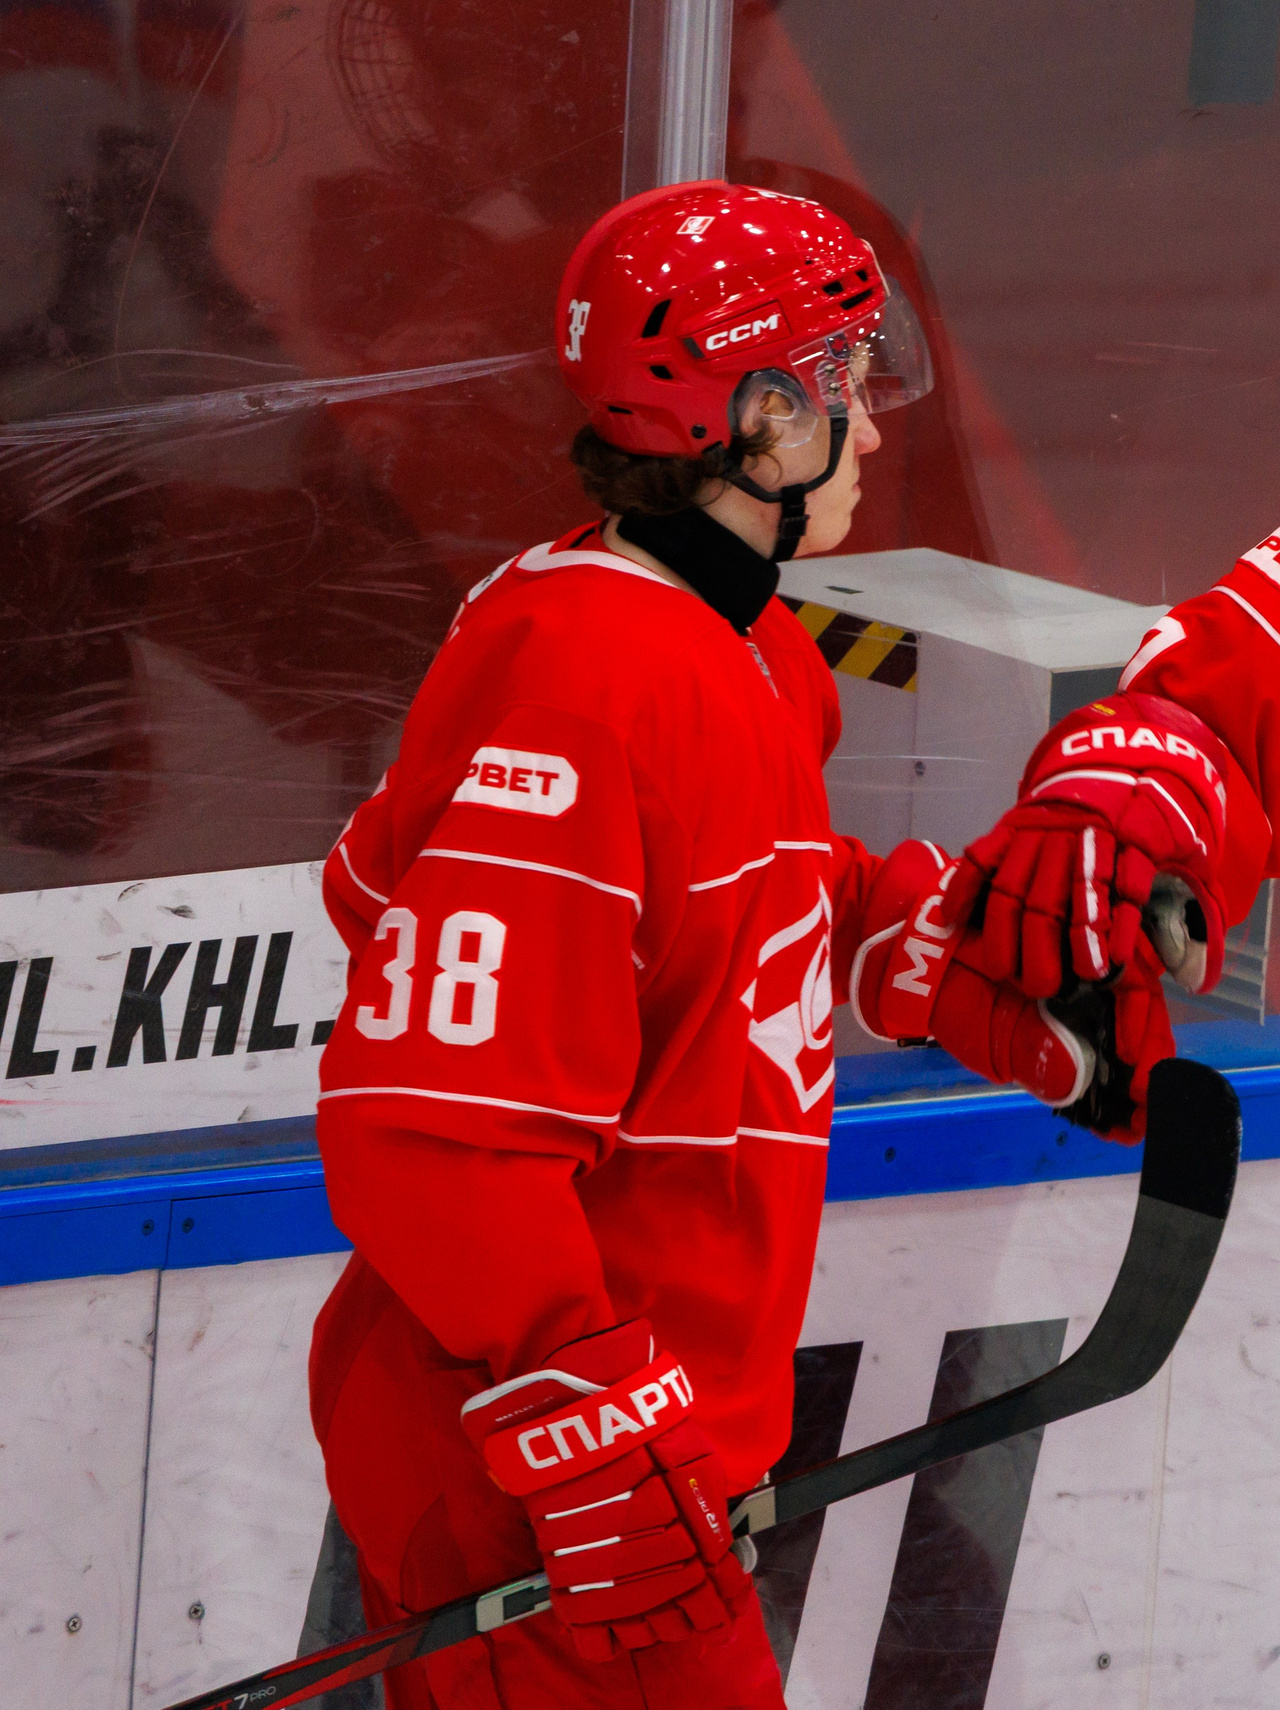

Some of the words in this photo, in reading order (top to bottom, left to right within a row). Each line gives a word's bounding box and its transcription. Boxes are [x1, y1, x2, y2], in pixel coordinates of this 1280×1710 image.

[705, 313, 781, 351] CCM
[1118, 617, 1187, 692] 7
[355, 907, 507, 1046] 38
[517, 1365, 693, 1470] СПАРТ
